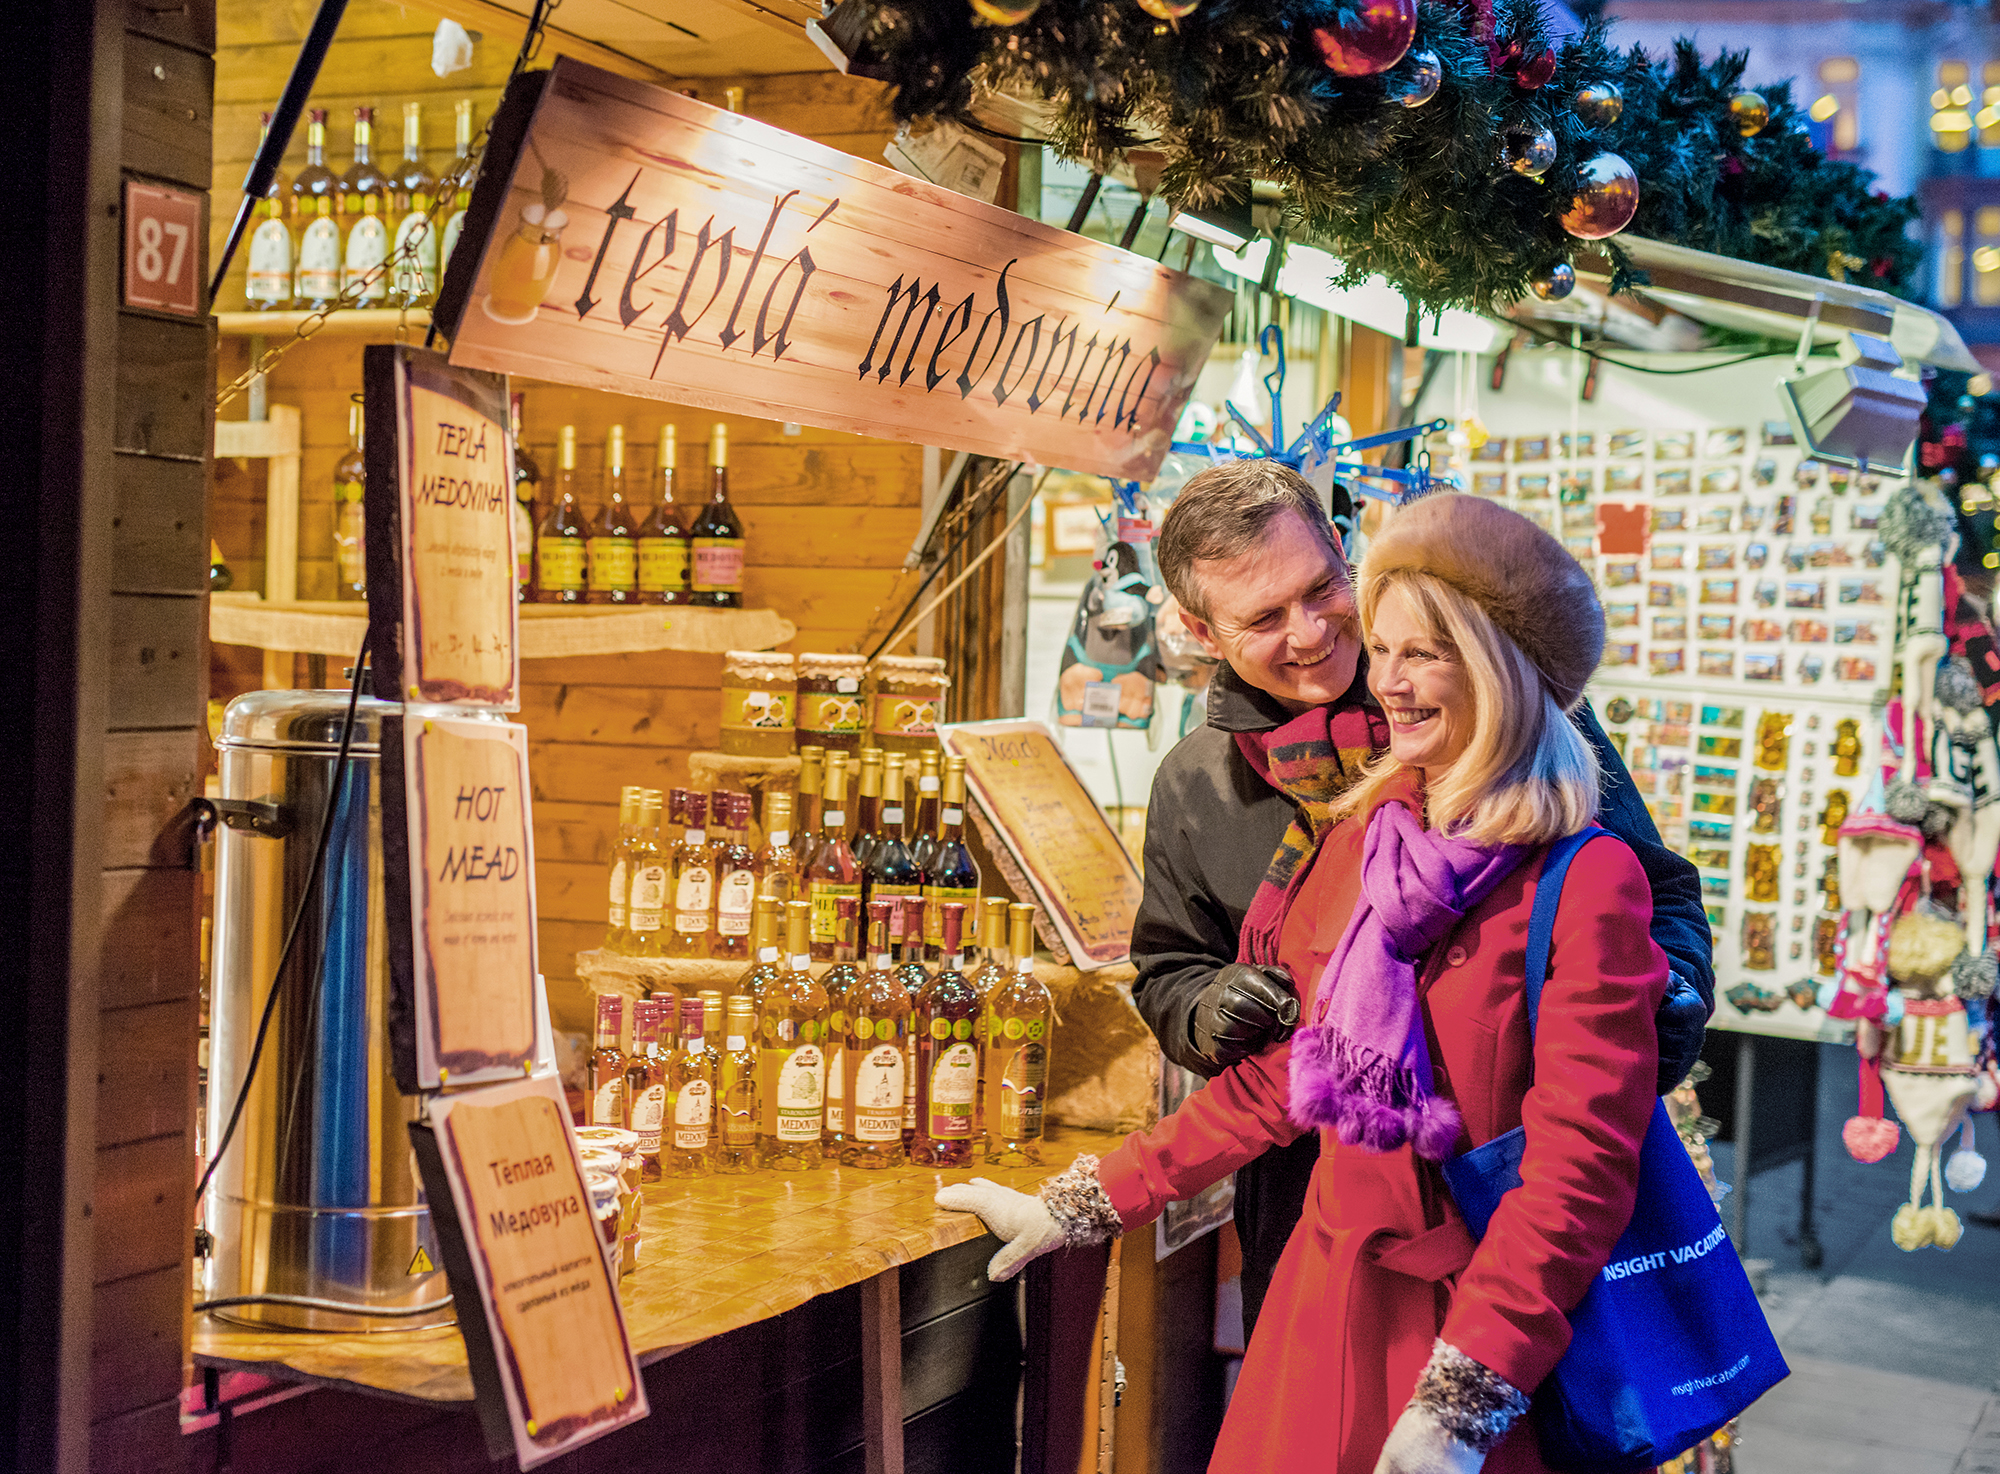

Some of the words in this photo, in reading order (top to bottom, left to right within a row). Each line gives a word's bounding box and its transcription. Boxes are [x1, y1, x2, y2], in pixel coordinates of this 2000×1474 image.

[137, 217, 188, 285] 87
[574, 167, 840, 379] teplá
[437, 422, 487, 463] TEPLÁ
[416, 474, 504, 515] MEDOVINA
[454, 785, 505, 822] HOT
[439, 846, 519, 883] MEAD
[488, 1152, 556, 1188] Тёплая
[489, 1193, 581, 1240] Медовуха
[1669, 1223, 1727, 1264] VACATIONS
